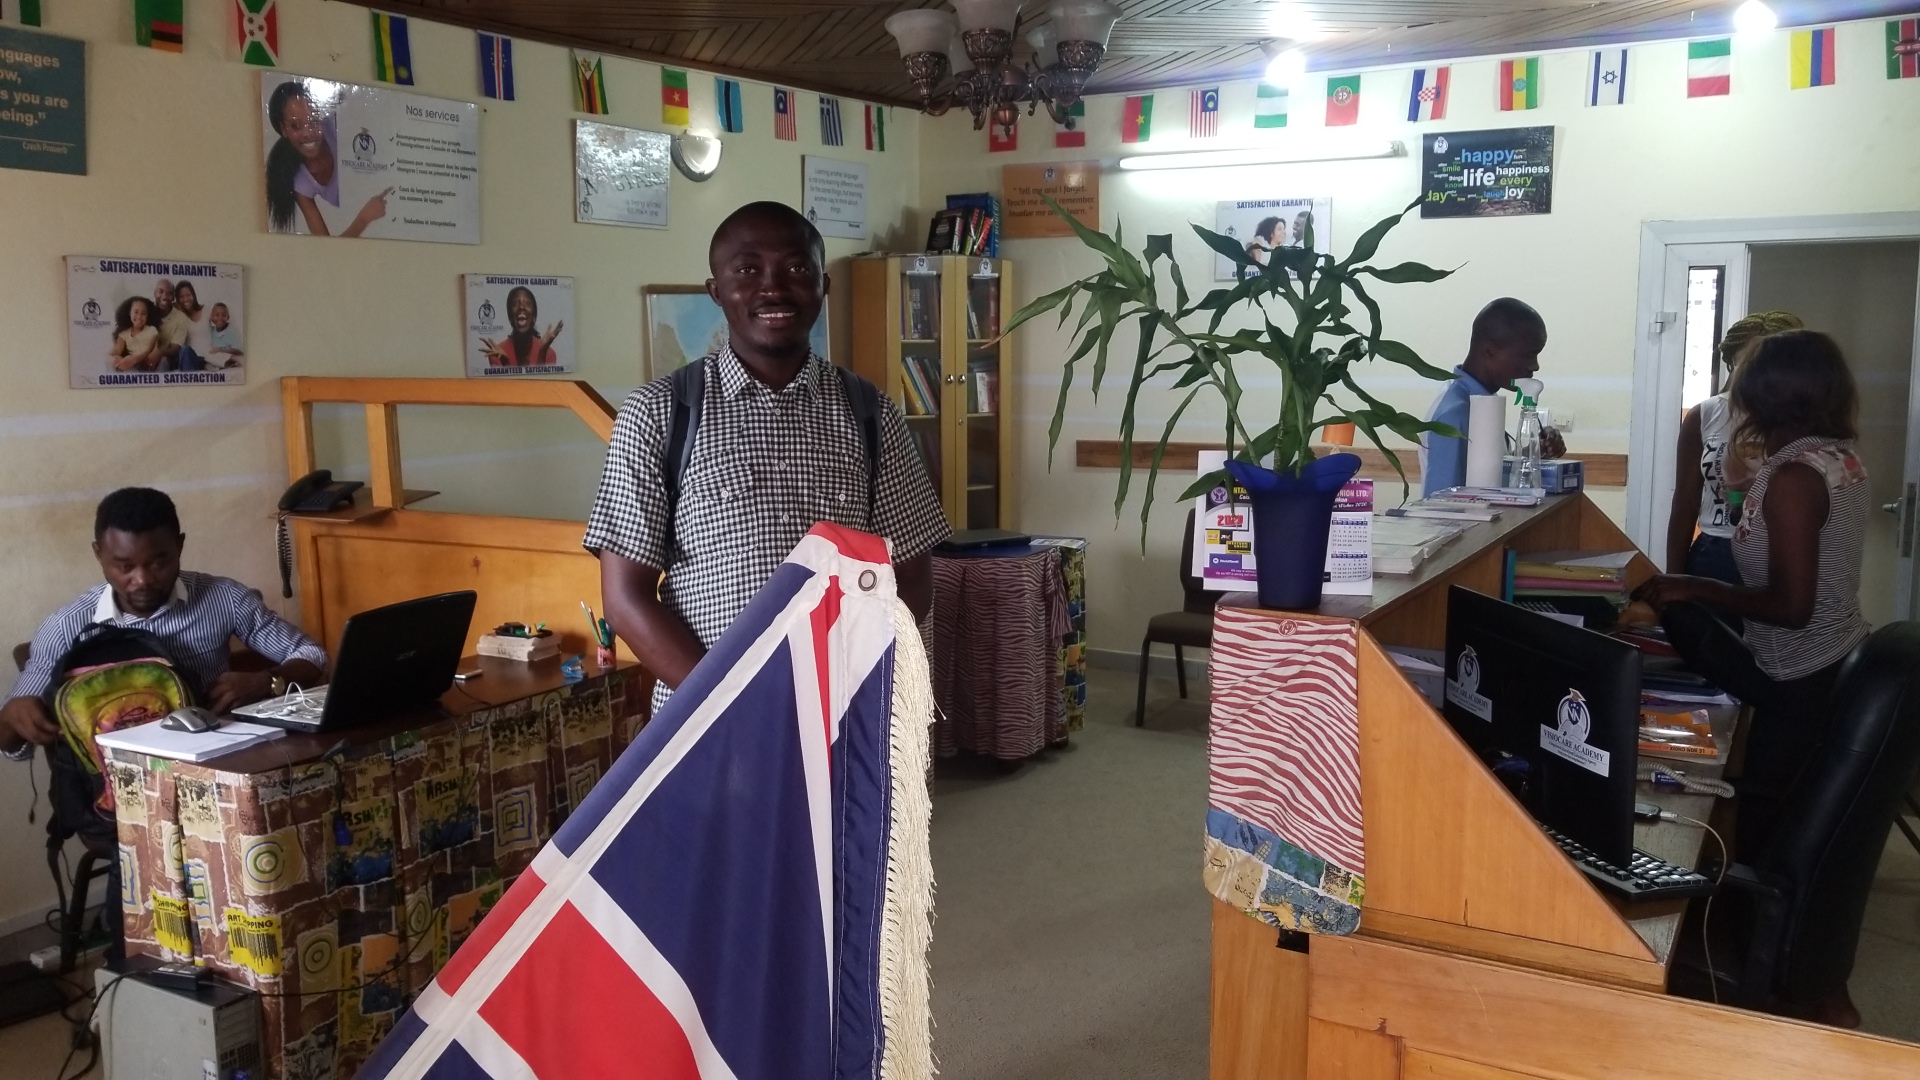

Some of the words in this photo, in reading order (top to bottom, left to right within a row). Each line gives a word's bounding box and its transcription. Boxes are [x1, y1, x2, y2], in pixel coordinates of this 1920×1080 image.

[13, 91, 40, 105] you
[44, 95, 69, 108] are
[406, 105, 423, 117] Nos
[425, 109, 460, 122] services
[1461, 149, 1514, 165] happy
[1443, 164, 1461, 172] smile
[1496, 165, 1549, 176] happiness
[1463, 168, 1495, 187] life
[1500, 176, 1532, 187] every
[1019, 187, 1030, 195] Tell
[1063, 185, 1087, 194] forget.
[1484, 190, 1505, 199] laugh
[1504, 186, 1525, 199] joy
[1007, 199, 1026, 207] Teach
[1236, 200, 1281, 209] SATISFACTION
[1008, 209, 1034, 217] Involve
[100, 260, 170, 276] SATISFACTION
[171, 264, 217, 277] GARANTIE
[486, 276, 529, 286] SATISFACTION
[529, 278, 558, 286] GARANTIE
[484, 367, 523, 375] GUARANTEED
[99, 374, 160, 385] GUARANTEED
[163, 373, 226, 384] SATISFACTION
[1716, 441, 1728, 459] YORK
[1702, 442, 1725, 527] DKNY
[1355, 489, 1369, 498] LTD.
[1543, 729, 1573, 749] VISIOCARE
[1573, 743, 1604, 762] ACADEMY
[228, 914, 241, 922] ART
